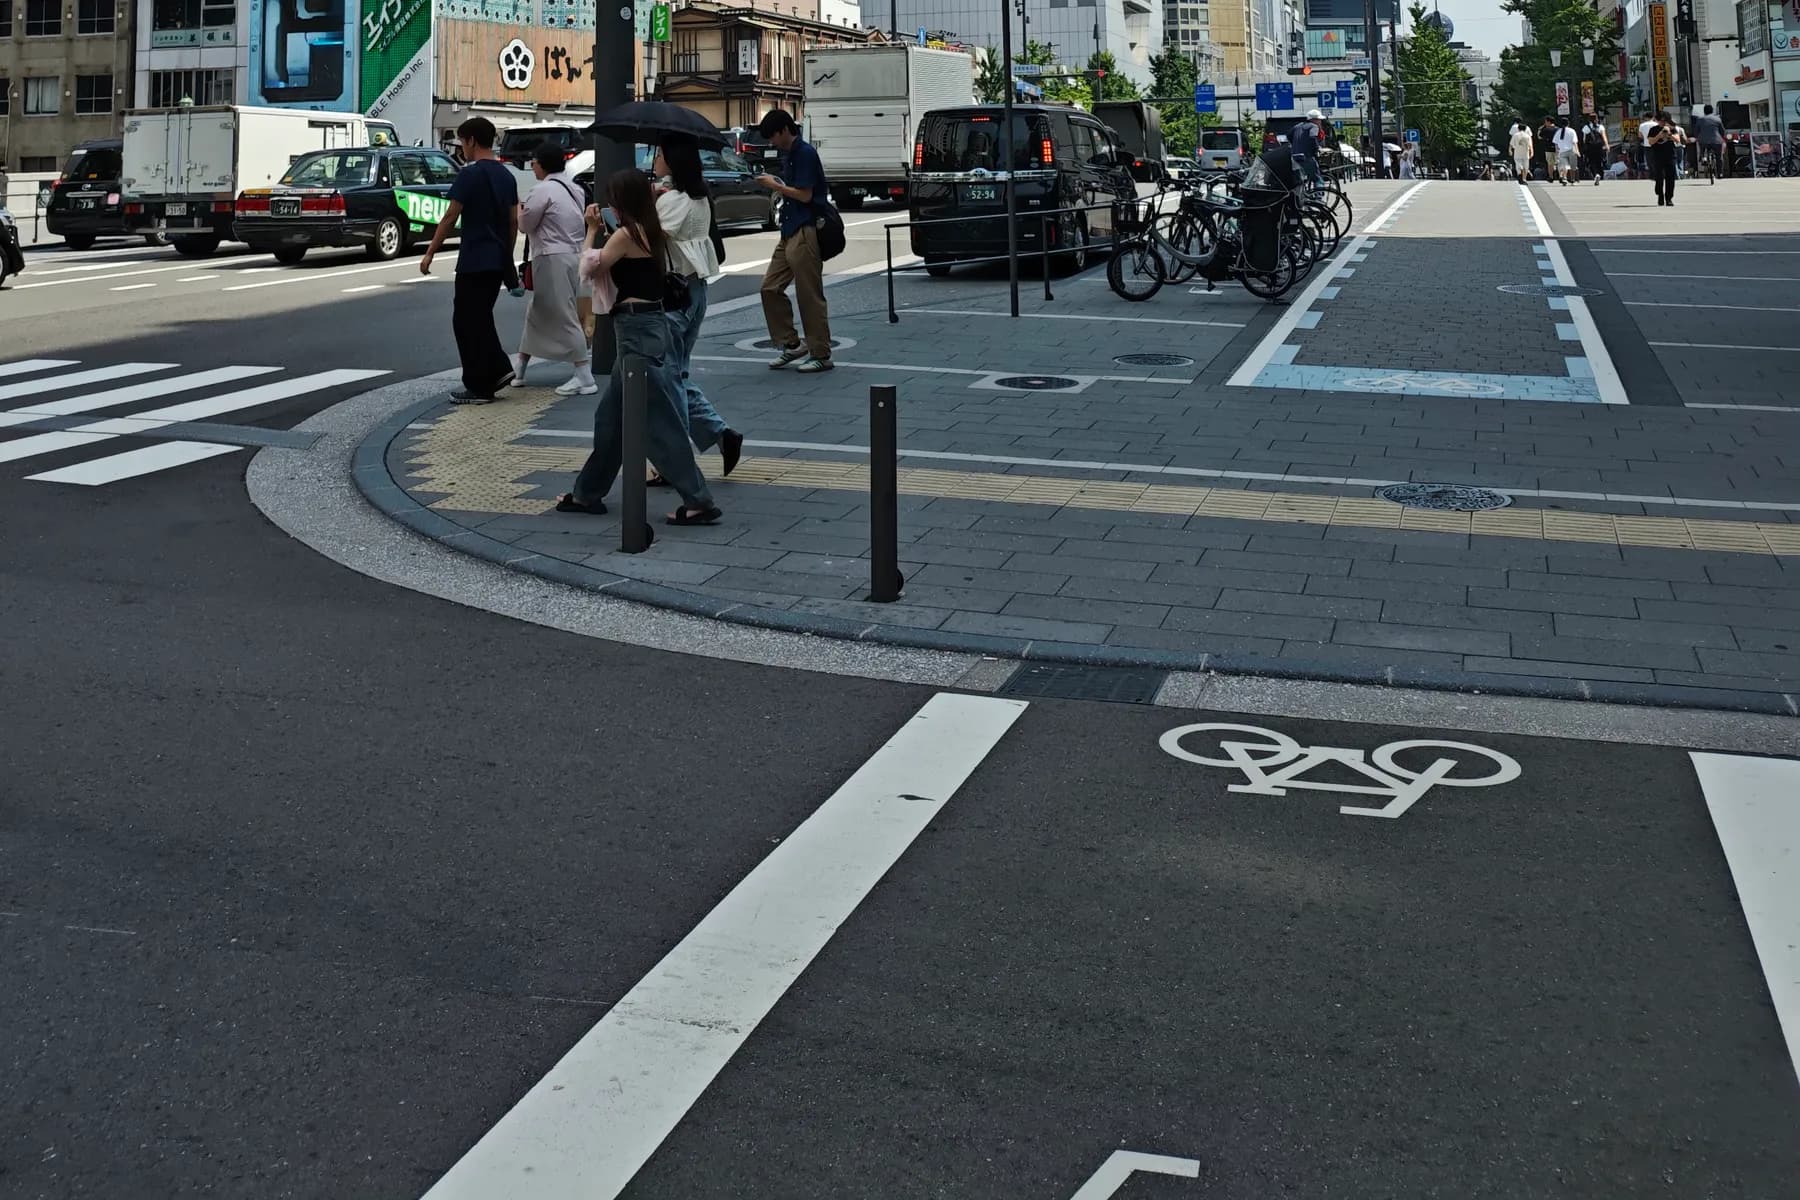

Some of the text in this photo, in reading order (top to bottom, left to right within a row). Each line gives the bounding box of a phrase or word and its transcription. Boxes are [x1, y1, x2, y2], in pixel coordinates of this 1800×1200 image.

[656, 7, 666, 37] レイク
[386, 73, 412, 101] Hosho
[410, 57, 424, 76] Inc
[1321, 92, 1332, 106] P
[1409, 130, 1418, 141] P
